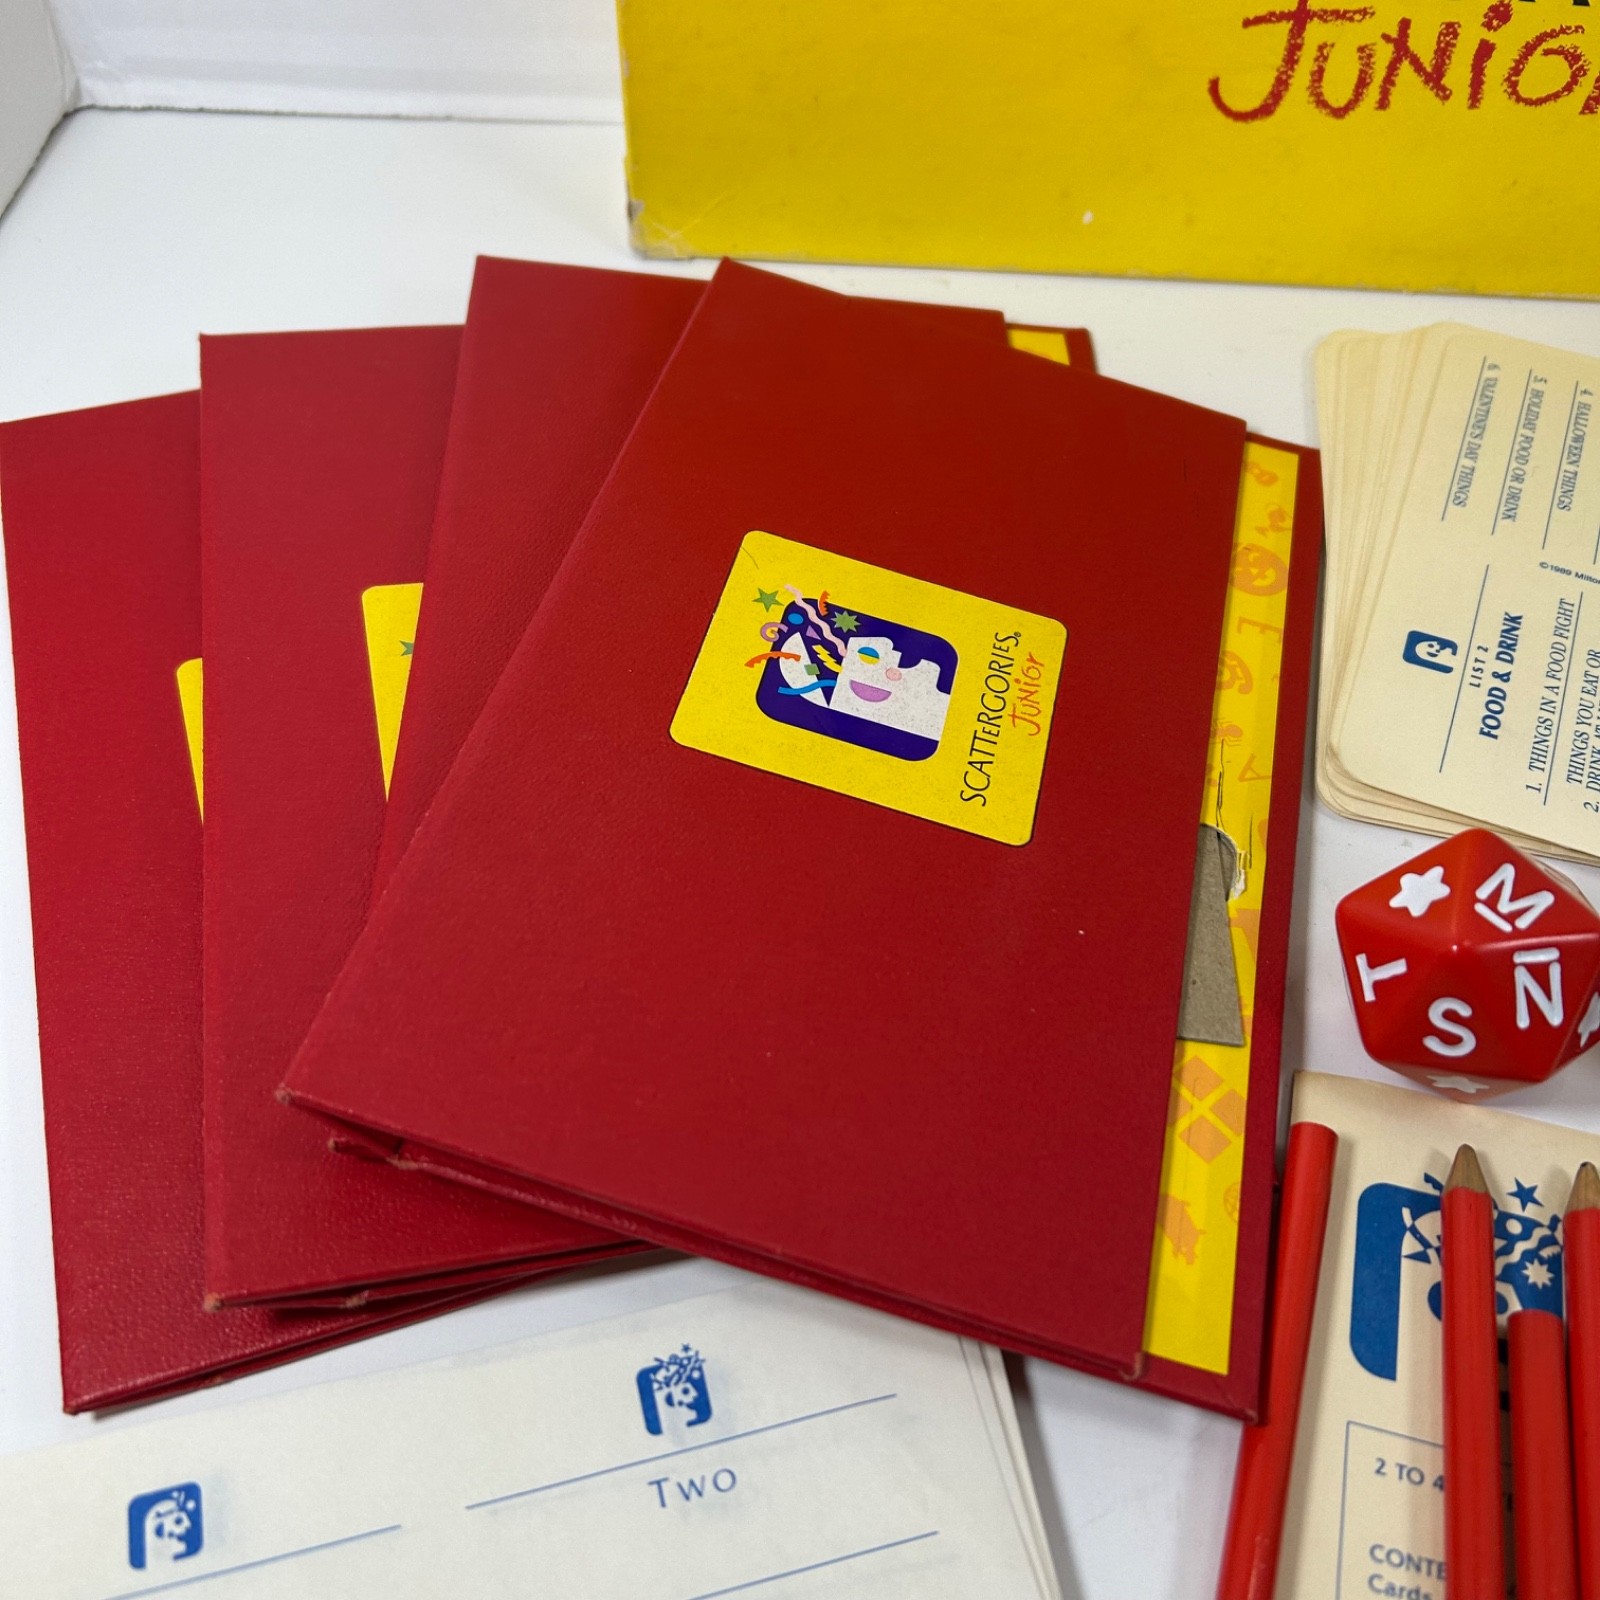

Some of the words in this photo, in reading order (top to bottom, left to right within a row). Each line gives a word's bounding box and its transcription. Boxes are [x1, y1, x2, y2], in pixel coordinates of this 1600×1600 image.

[1523, 388, 1544, 434] HOLIDAY
[1464, 441, 1481, 463] DAY
[1515, 434, 1534, 466] FOOD
[1566, 401, 1592, 468] HALLOWEEN
[1452, 465, 1475, 507] THINGS
[1510, 466, 1526, 485] OR
[1557, 469, 1578, 511] THINGS
[1501, 485, 1523, 522] DRINK
[1495, 611, 1523, 665] DRINK
[1553, 598, 1575, 640] FIGHT
[1477, 645, 1489, 653] 2
[1546, 641, 1567, 682] FOOD
[1469, 657, 1486, 688] LIST
[1492, 670, 1512, 683] &
[1544, 685, 1560, 696] A
[1581, 670, 1600, 697] EAT
[1479, 686, 1507, 740] FOOD
[1539, 697, 1557, 715] IN
[1576, 698, 1595, 727] YOU
[1529, 716, 1554, 773] THINGS
[1567, 730, 1590, 784] THINGS
[1474, 863, 1565, 932] M
[1355, 953, 1408, 1002] T
[1513, 949, 1564, 1029] N
[1422, 996, 1477, 1057] S
[1375, 1457, 1388, 1476] 2
[1395, 1462, 1425, 1485] TO
